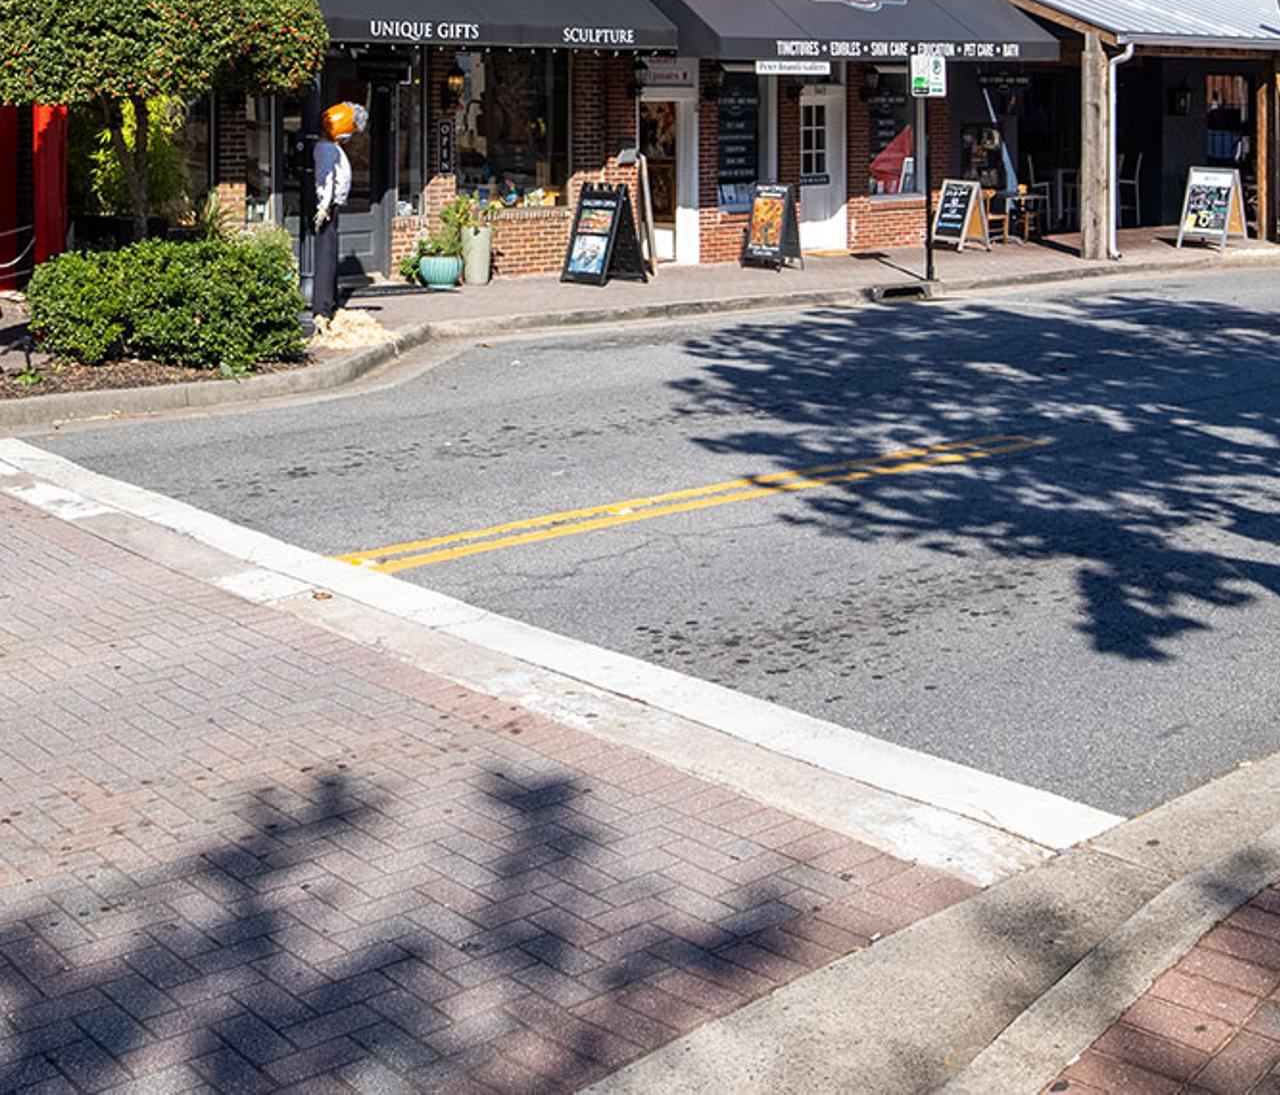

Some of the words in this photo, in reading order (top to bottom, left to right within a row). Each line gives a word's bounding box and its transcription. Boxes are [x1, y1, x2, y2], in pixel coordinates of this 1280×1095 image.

[370, 20, 433, 40] UNIQUE
[437, 22, 480, 39] GIFTS
[562, 26, 635, 44] SCULPTURE
[441, 124, 450, 170] OPEN
